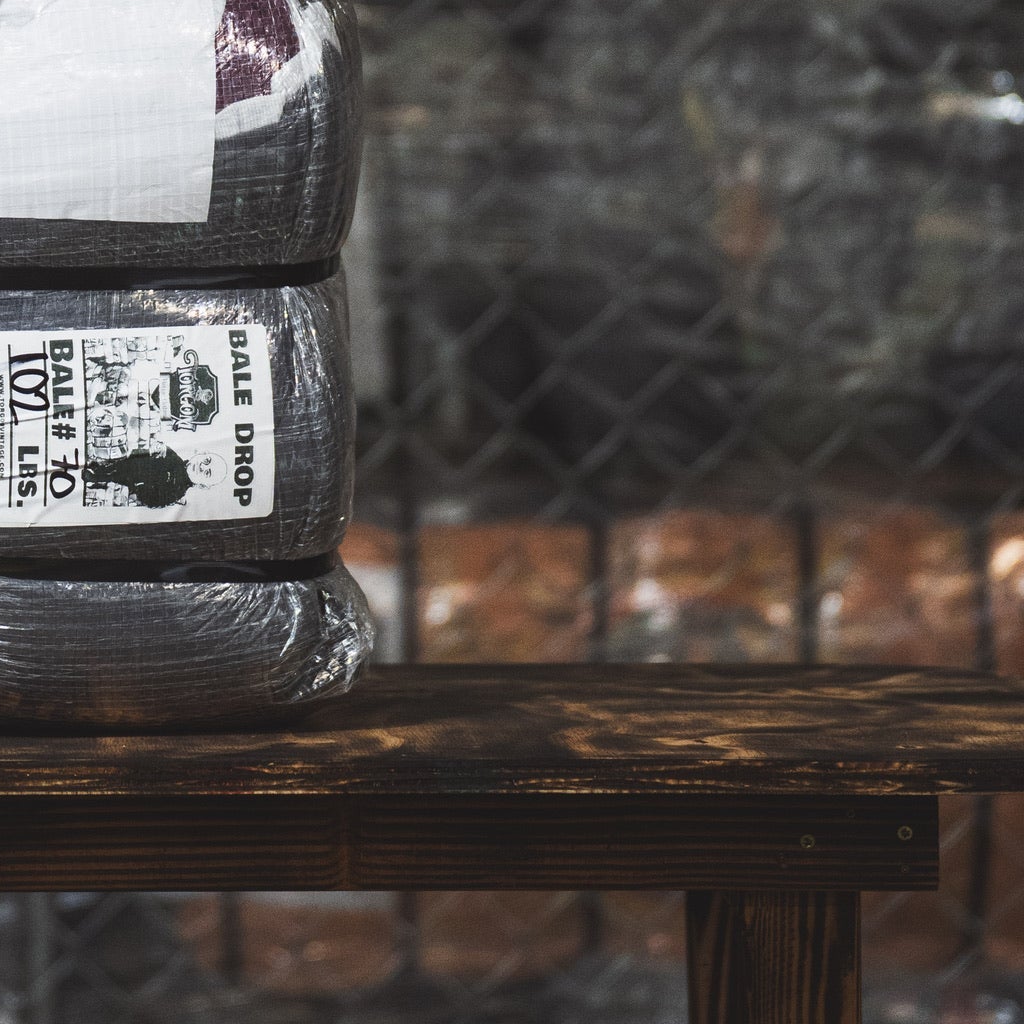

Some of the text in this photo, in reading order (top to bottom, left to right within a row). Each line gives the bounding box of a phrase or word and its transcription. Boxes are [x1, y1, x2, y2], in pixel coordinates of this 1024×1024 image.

[9, 352, 51, 507] 102 LBS.
[50, 448, 80, 499] 70
[228, 329, 254, 507] BALE DROP
